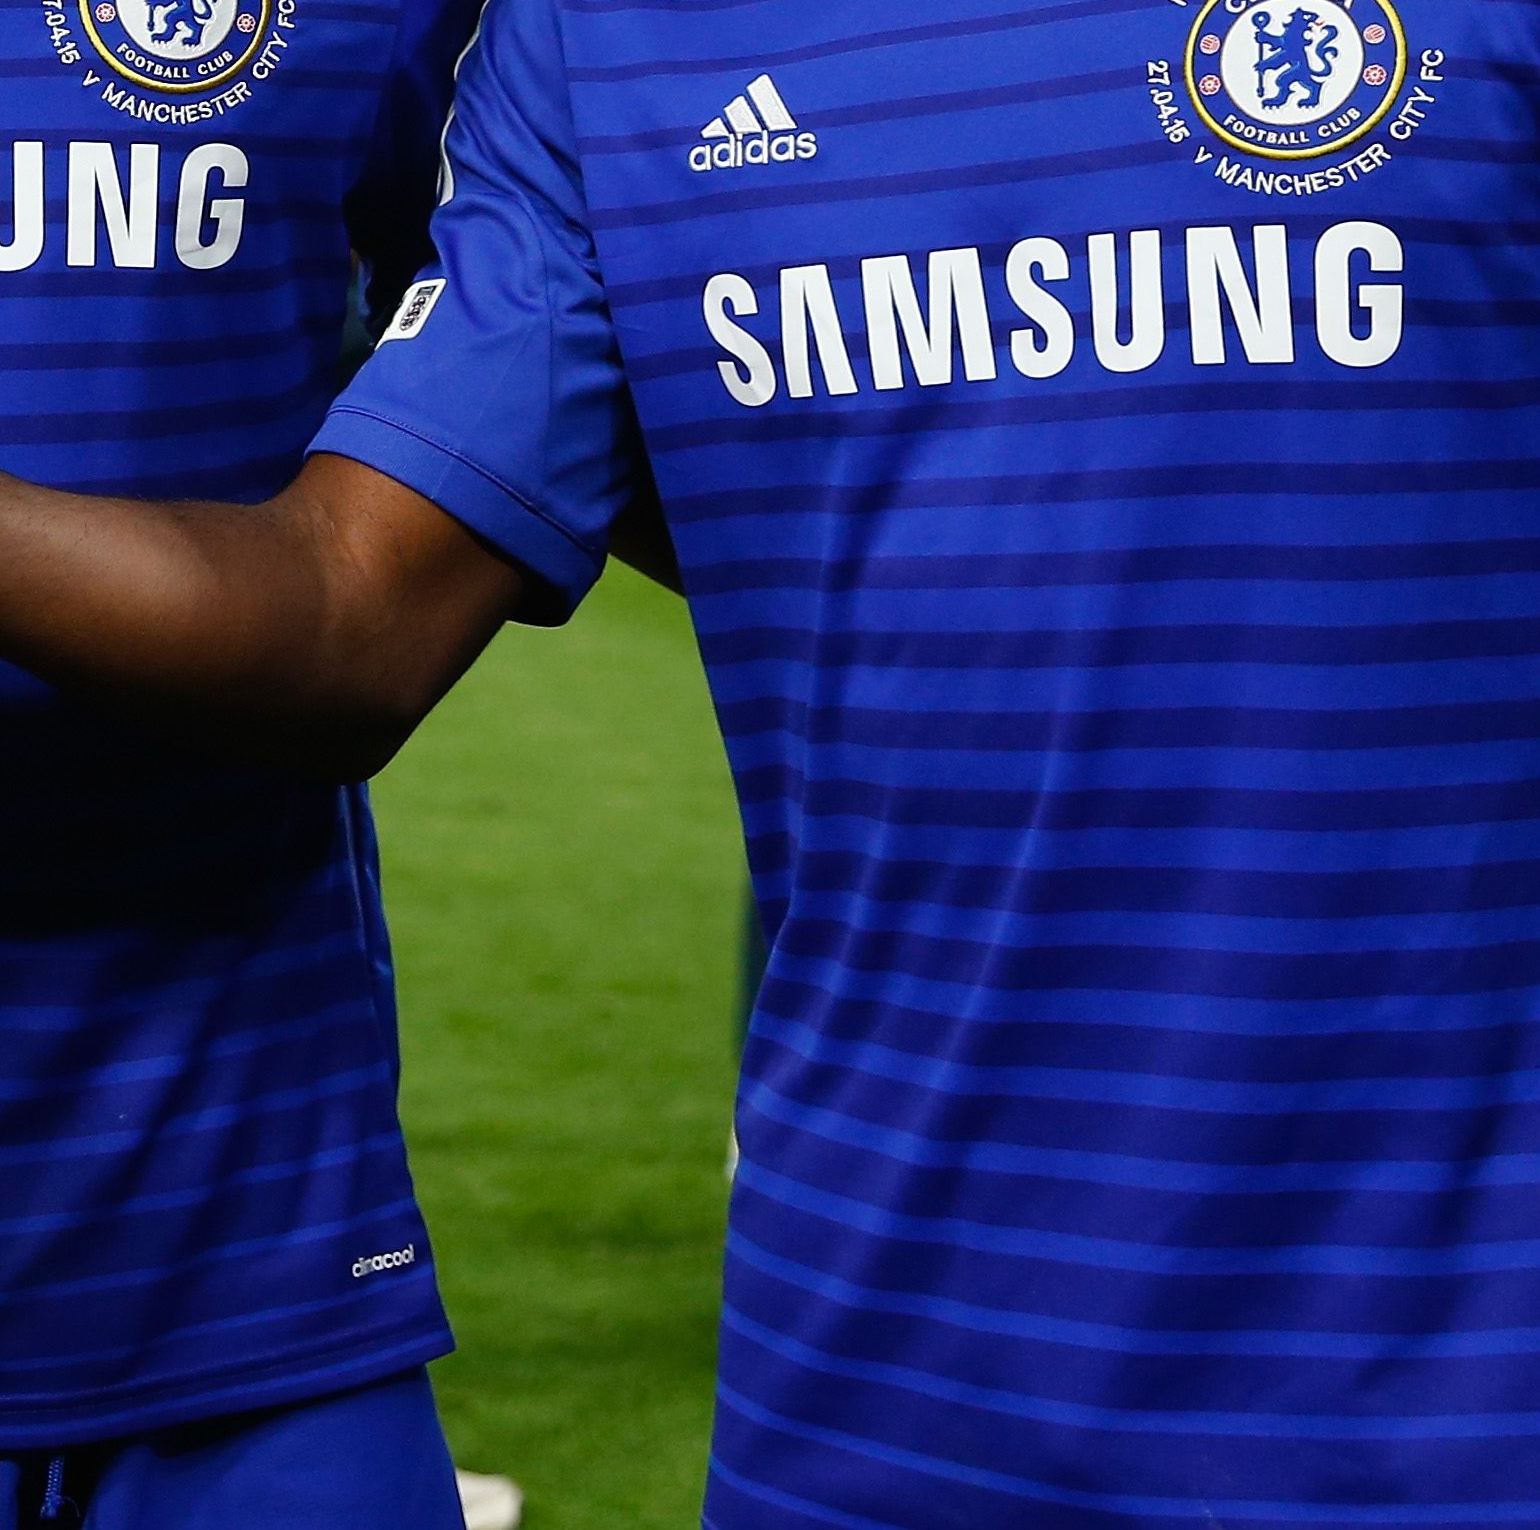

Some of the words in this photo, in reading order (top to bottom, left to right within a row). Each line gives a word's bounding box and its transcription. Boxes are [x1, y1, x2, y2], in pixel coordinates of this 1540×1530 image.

[101, 81, 253, 125] MANCHESTER
[252, 31, 289, 80] CITY
[116, 43, 191, 79] FOOTBALL
[197, 50, 234, 76] CLUB
[688, 129, 819, 172] adidas
[1214, 142, 1393, 196] MANCHESTER
[1388, 85, 1436, 141] CITY
[1419, 48, 1446, 82] FC
[1223, 113, 1310, 145] FOOTBALL
[1317, 106, 1363, 139] CLUB
[701, 220, 1406, 408] SAMSUNG
